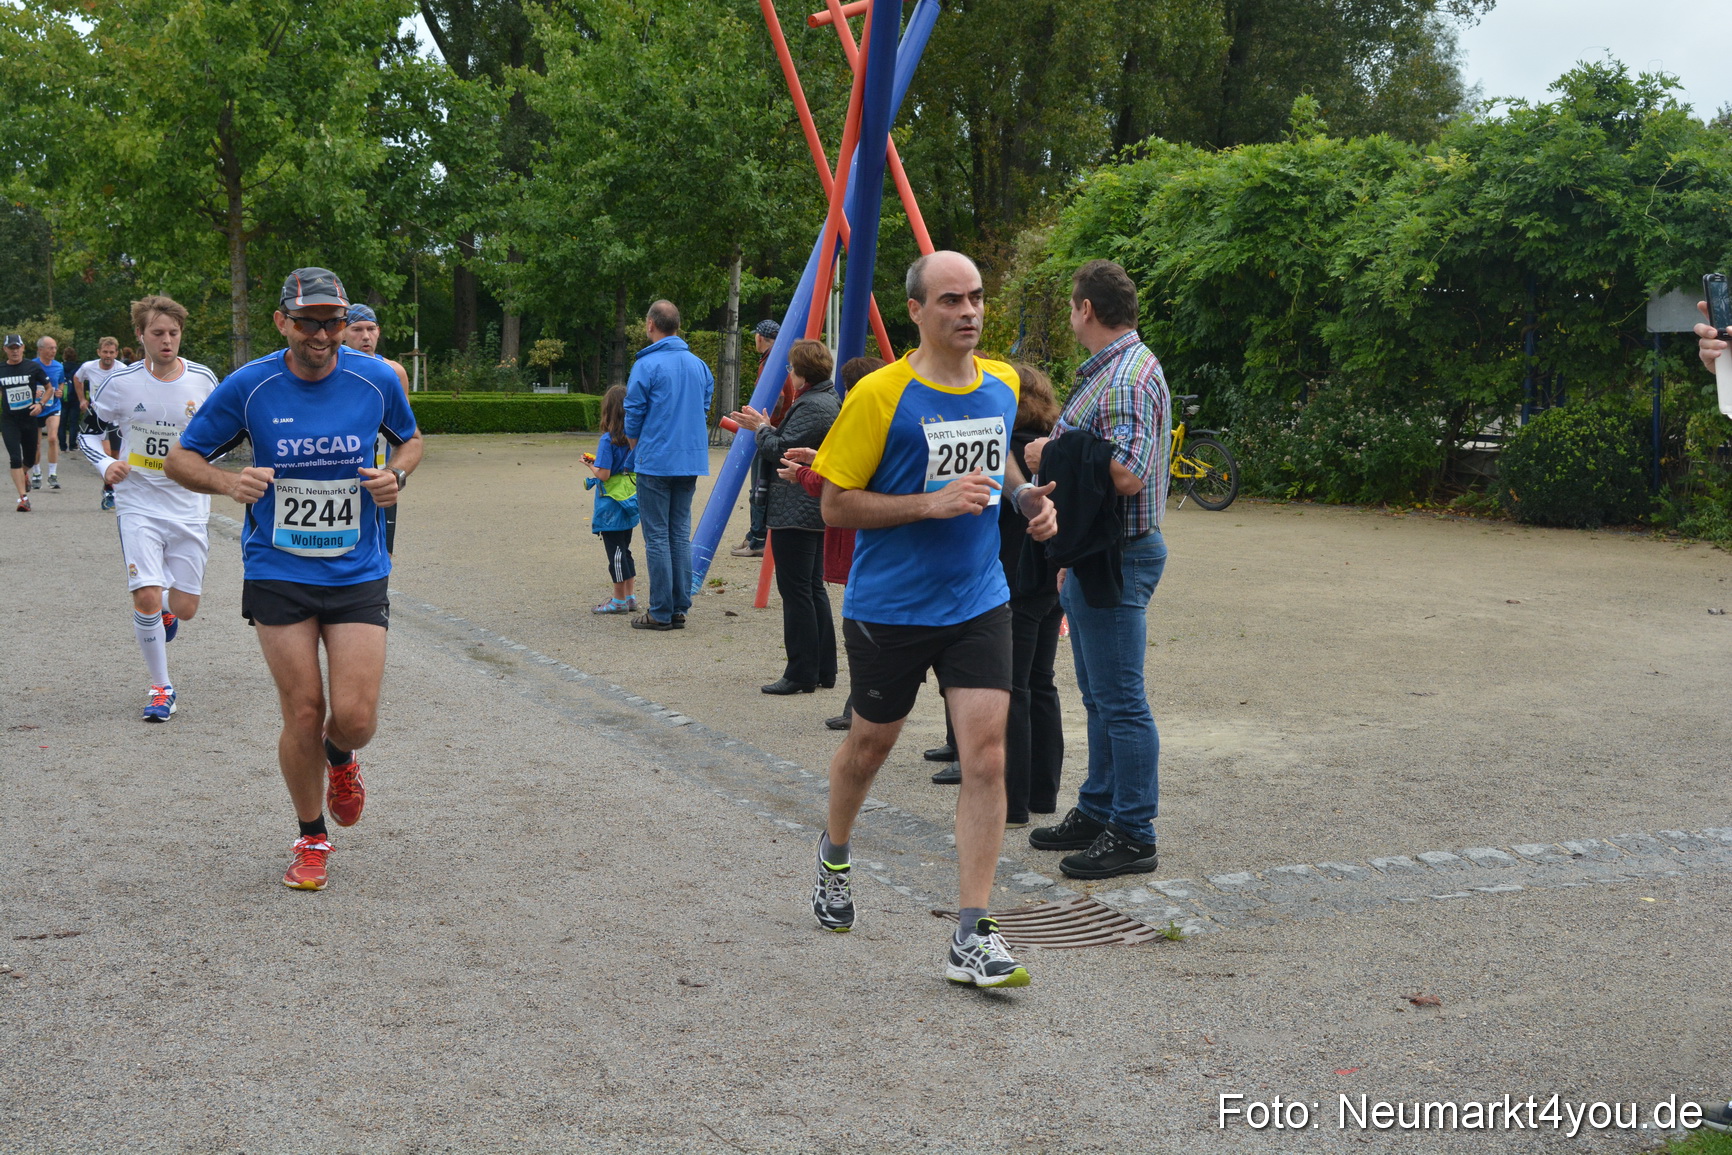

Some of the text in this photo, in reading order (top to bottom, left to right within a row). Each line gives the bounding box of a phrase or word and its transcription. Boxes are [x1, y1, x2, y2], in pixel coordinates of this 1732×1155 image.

[0, 375, 30, 386] THULE
[10, 391, 31, 402] 2079
[131, 425, 149, 434] PARTL
[927, 427, 993, 441] PARTL Neumarkt
[146, 437, 169, 457] 65
[276, 435, 361, 457] SYSCAD
[274, 457, 364, 468] www.metallbau-cad.de
[937, 439, 1000, 476] 2826
[144, 459, 163, 471] Felip
[276, 485, 346, 496] PARTL Neumarkt
[283, 497, 354, 527] 2244
[291, 533, 343, 548] Wolfgang
